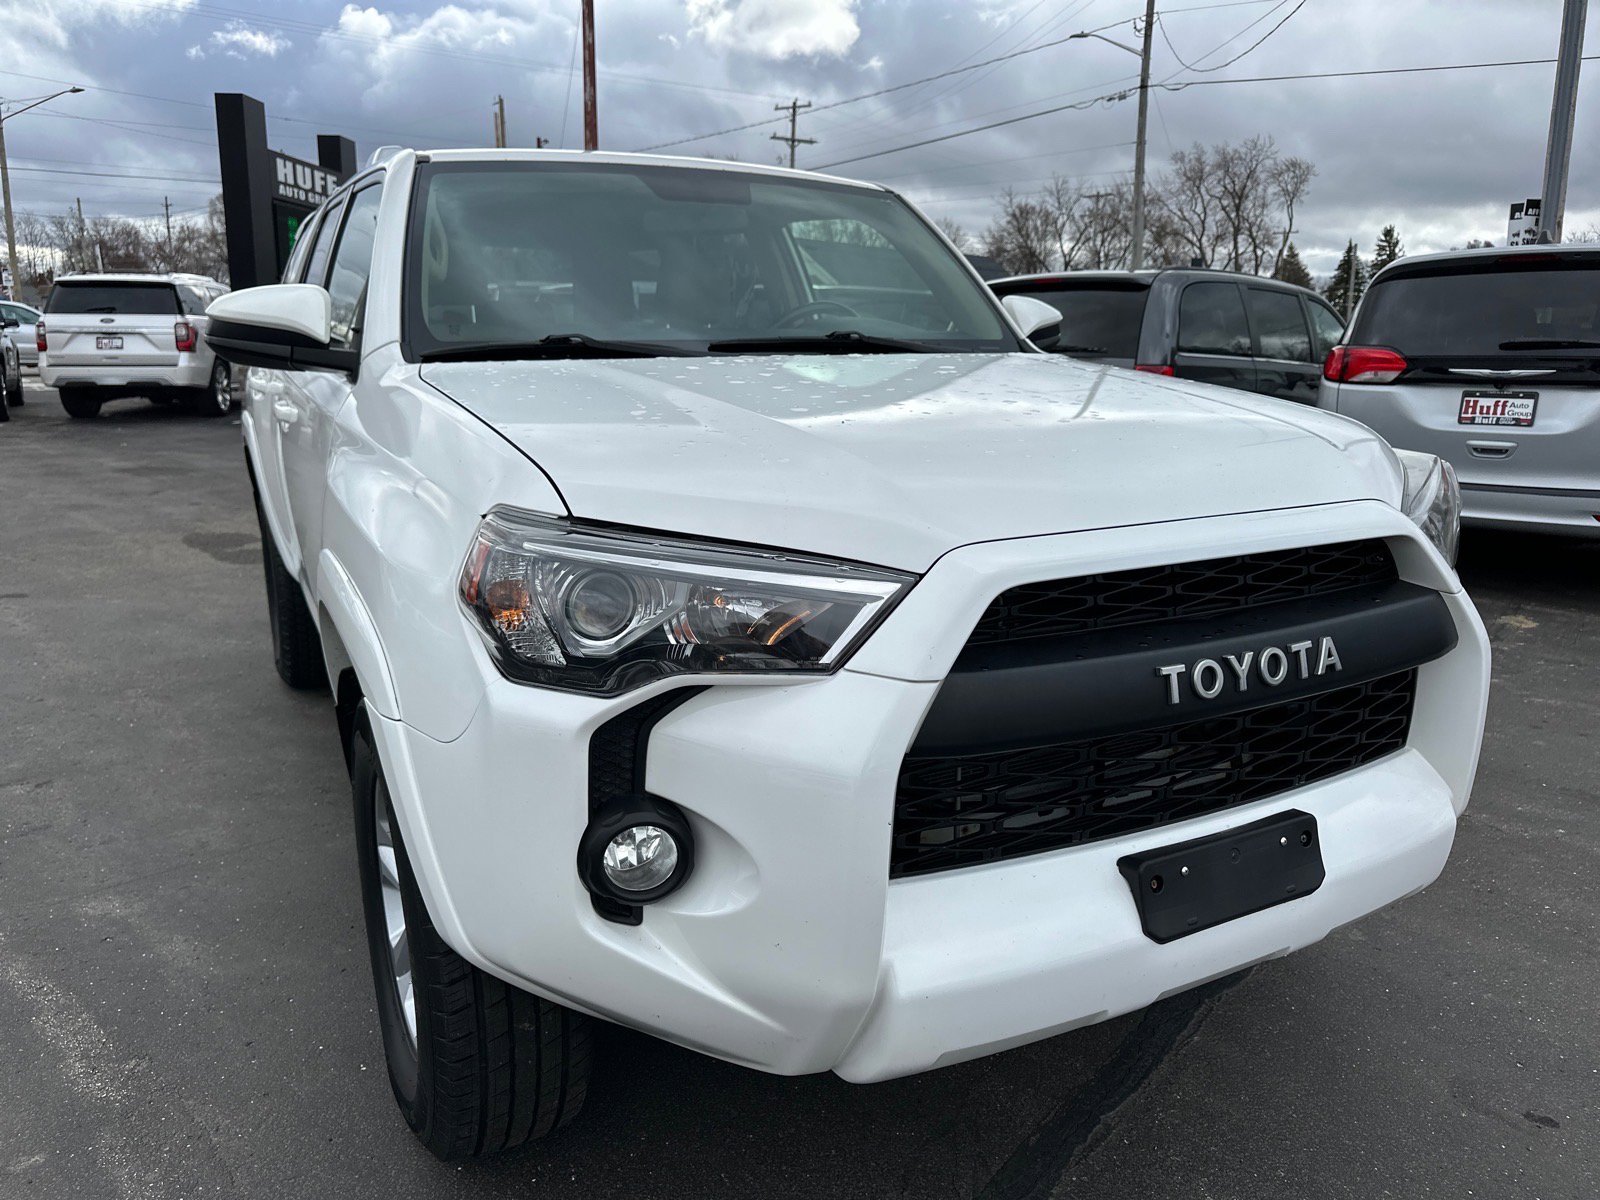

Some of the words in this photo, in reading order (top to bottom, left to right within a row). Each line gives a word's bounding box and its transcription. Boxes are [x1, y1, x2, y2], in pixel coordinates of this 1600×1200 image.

[276, 157, 337, 196] HUFF
[278, 184, 306, 201] AUTO
[1462, 399, 1509, 416] Huff
[1507, 410, 1532, 418] Group
[1156, 636, 1342, 704] TOYOTA
